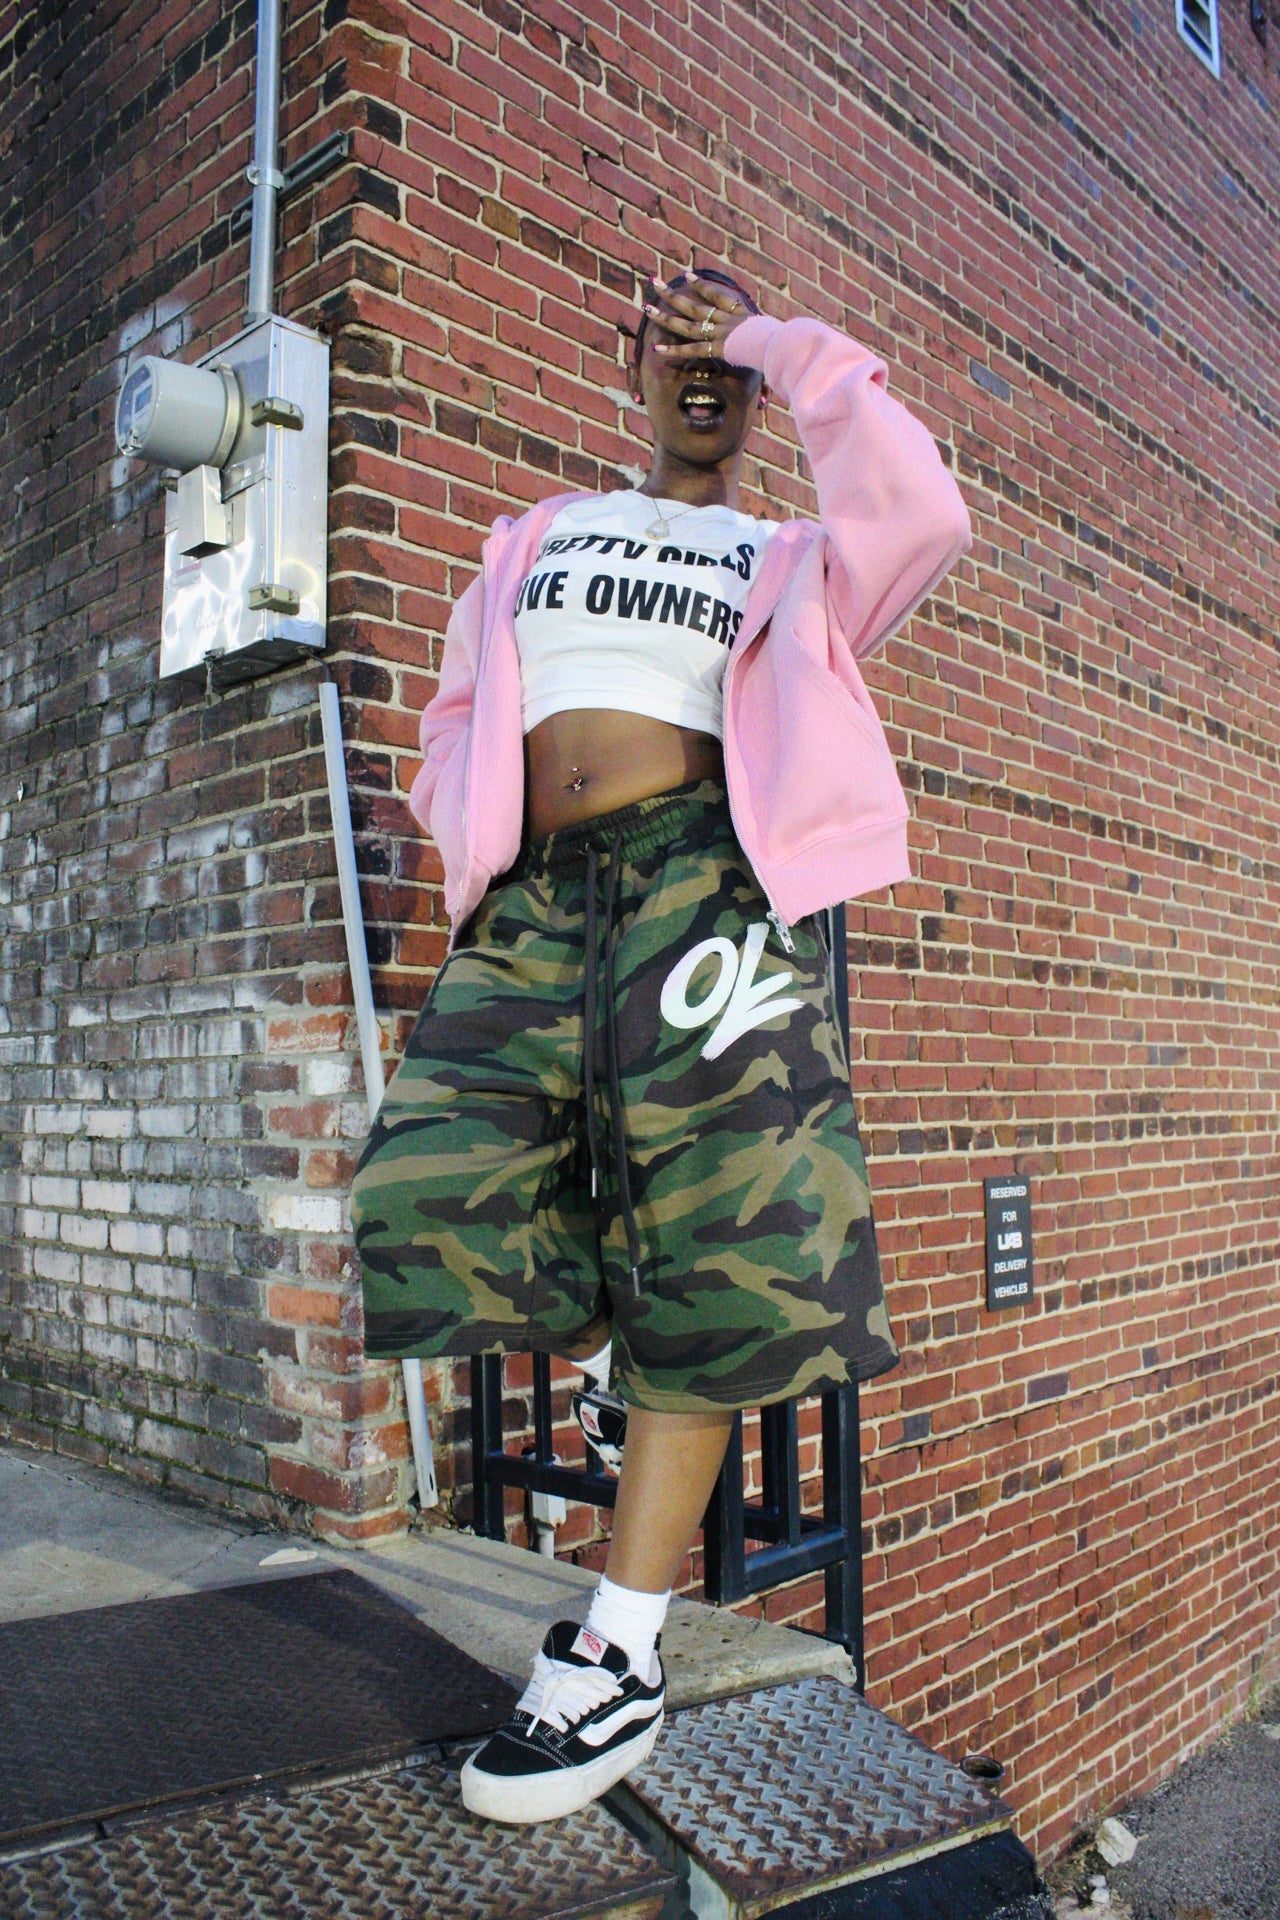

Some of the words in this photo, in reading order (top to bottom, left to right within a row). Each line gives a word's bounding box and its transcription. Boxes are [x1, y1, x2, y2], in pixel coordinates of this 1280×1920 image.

[585, 574, 744, 650] OWNERS
[990, 1185, 1026, 1199] RESERVED
[1002, 1211, 1017, 1222] FOR
[994, 1259, 1027, 1274] DELIVERY
[994, 1283, 1028, 1298] VEHICLES
